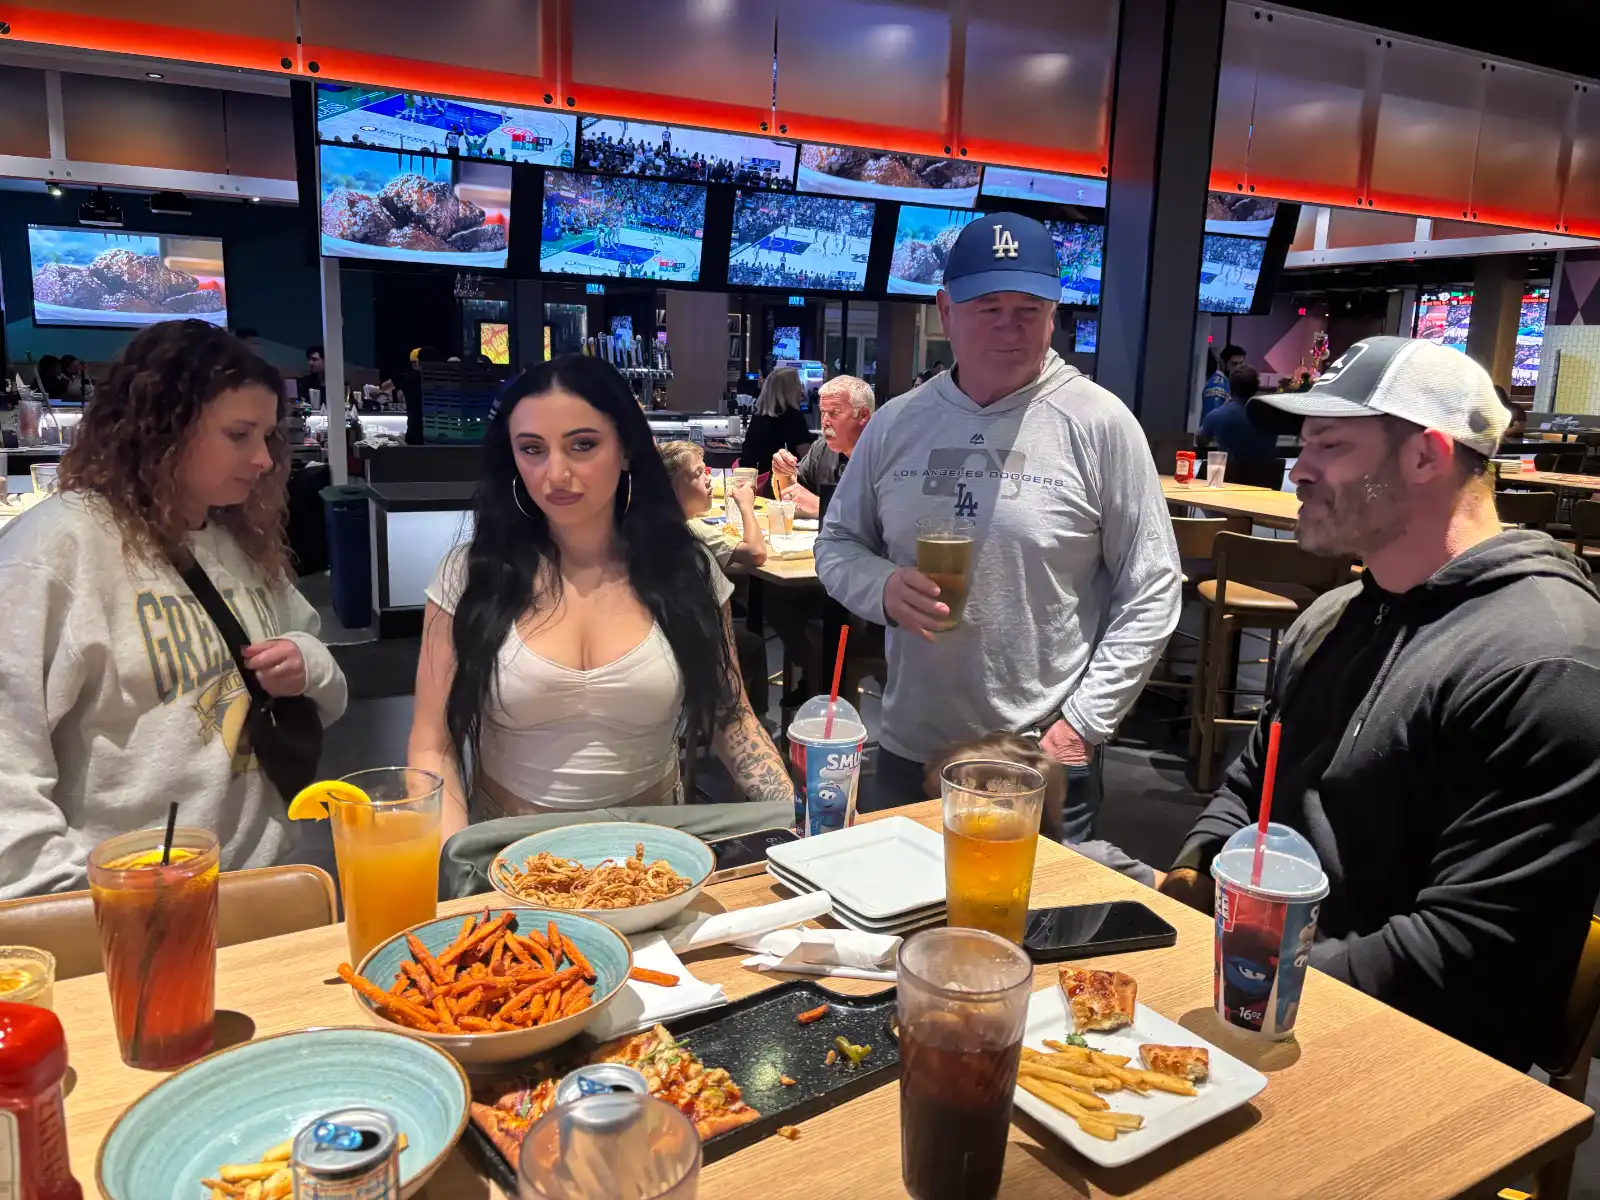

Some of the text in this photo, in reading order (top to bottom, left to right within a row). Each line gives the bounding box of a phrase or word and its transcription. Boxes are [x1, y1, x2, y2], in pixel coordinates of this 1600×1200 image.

[992, 224, 1019, 258] LA
[893, 469, 1065, 487] LOS ANGELES DODGERS
[954, 483, 979, 517] LA
